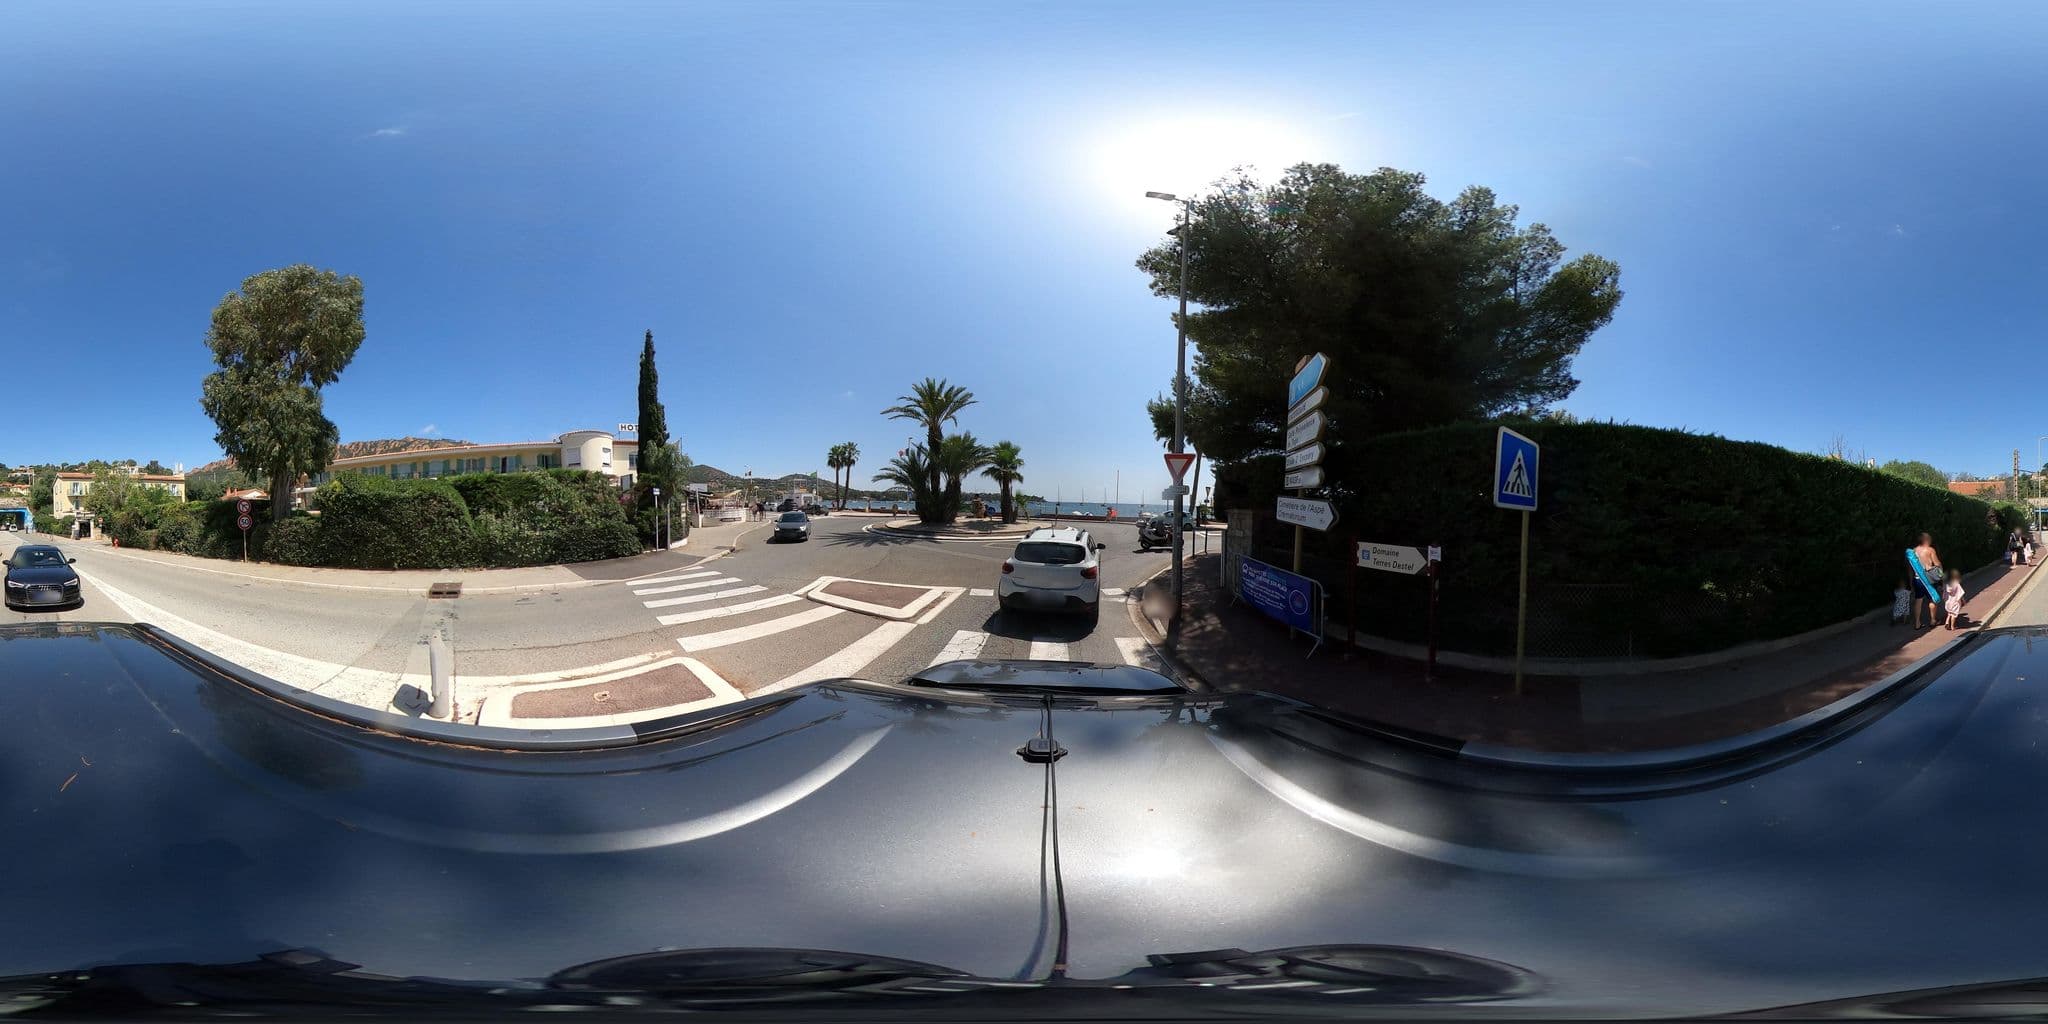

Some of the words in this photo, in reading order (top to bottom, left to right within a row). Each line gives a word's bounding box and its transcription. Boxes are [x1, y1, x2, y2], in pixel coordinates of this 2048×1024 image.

[1300, 502, 1306, 511] de
[1372, 546, 1399, 557] Domaine
[1373, 558, 1391, 568] Terres
[1392, 560, 1414, 571] Destel
